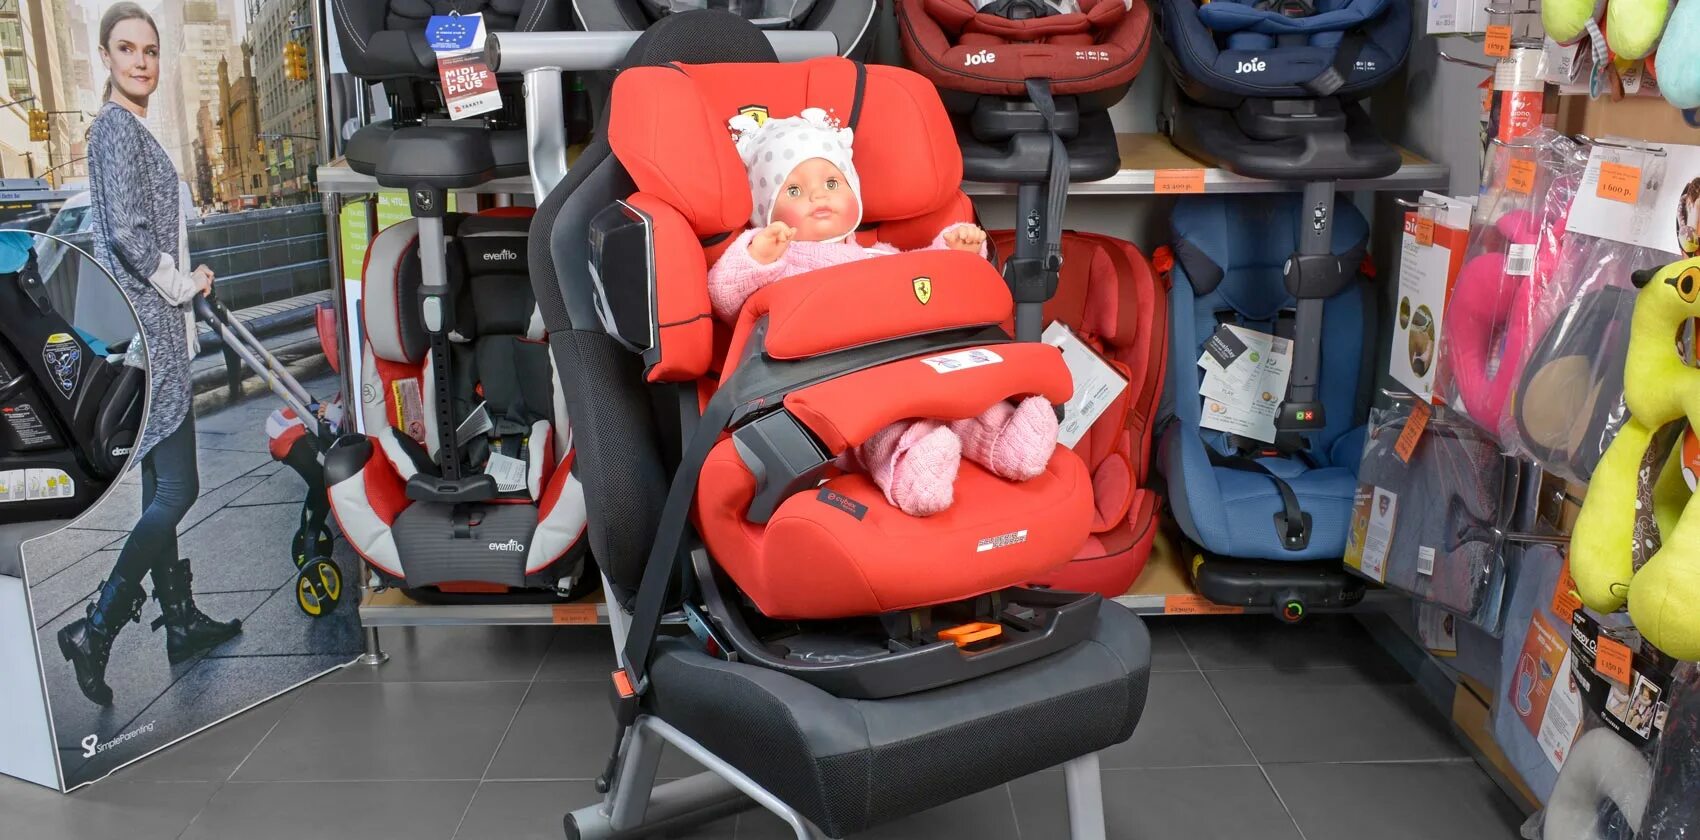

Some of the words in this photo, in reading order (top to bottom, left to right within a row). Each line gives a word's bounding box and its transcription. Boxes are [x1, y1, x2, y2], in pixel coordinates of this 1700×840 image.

[964, 50, 996, 66] Joie
[1235, 57, 1266, 74] Joie
[445, 66, 475, 79] MIDI
[445, 70, 488, 86] I-SIZE
[448, 79, 484, 95] PLUS
[483, 249, 517, 260] evenflo
[488, 539, 525, 552] evenflo
